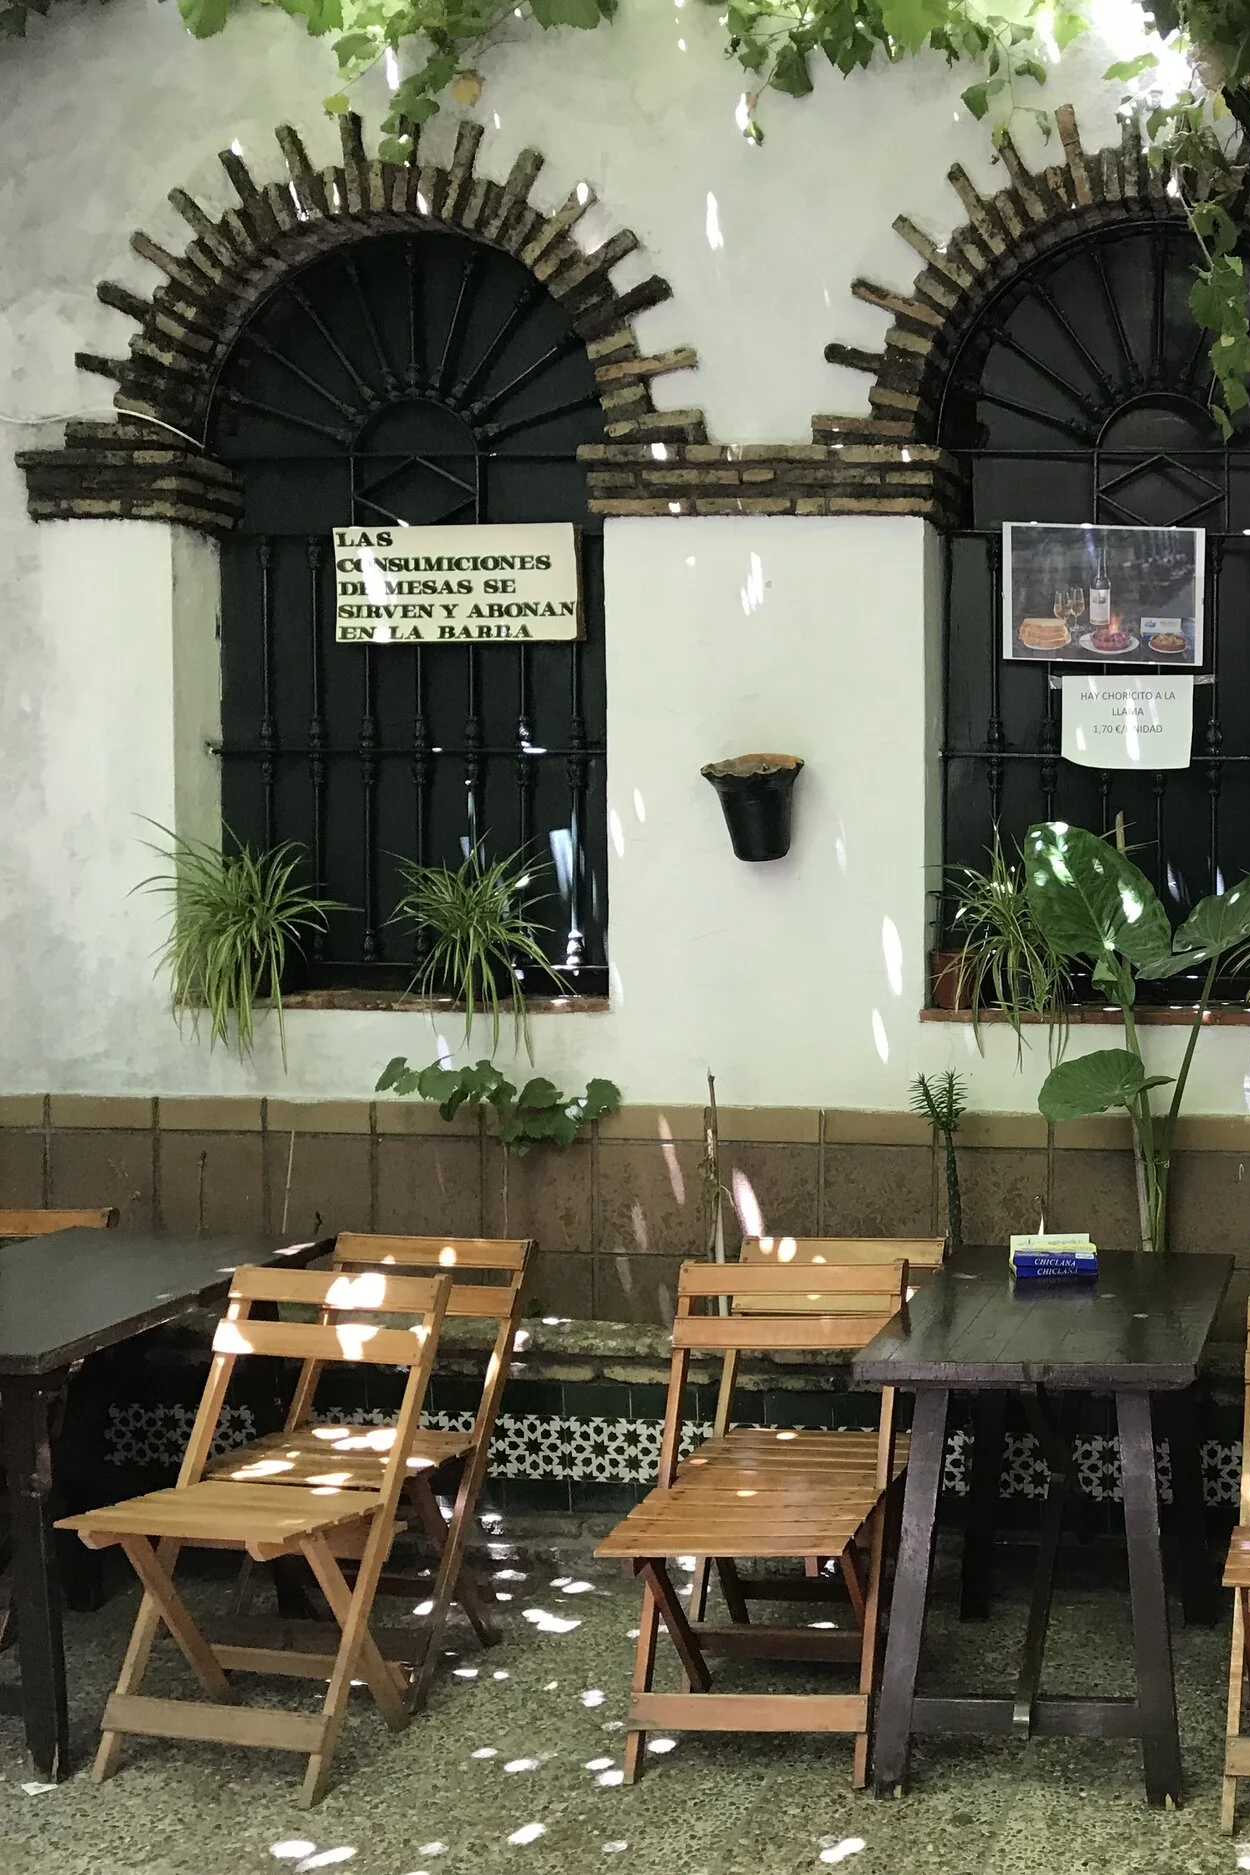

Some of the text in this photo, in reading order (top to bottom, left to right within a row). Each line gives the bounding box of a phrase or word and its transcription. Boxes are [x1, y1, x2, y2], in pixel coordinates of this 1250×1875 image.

[336, 531, 394, 548] LAS
[384, 578, 473, 596] MESAS
[483, 578, 517, 595] SE
[337, 601, 576, 620] SIRVEN Y ABONAN
[338, 623, 533, 640] EN LA BARRA
[1080, 691, 1176, 701] HAY CHORICITO A LA
[1111, 707, 1144, 717] LLAMA
[1093, 724, 1163, 735] 1,70 €/NIDAD
[1034, 1258, 1076, 1267] CHICLANA
[1036, 1267, 1078, 1276] CHICLANA
